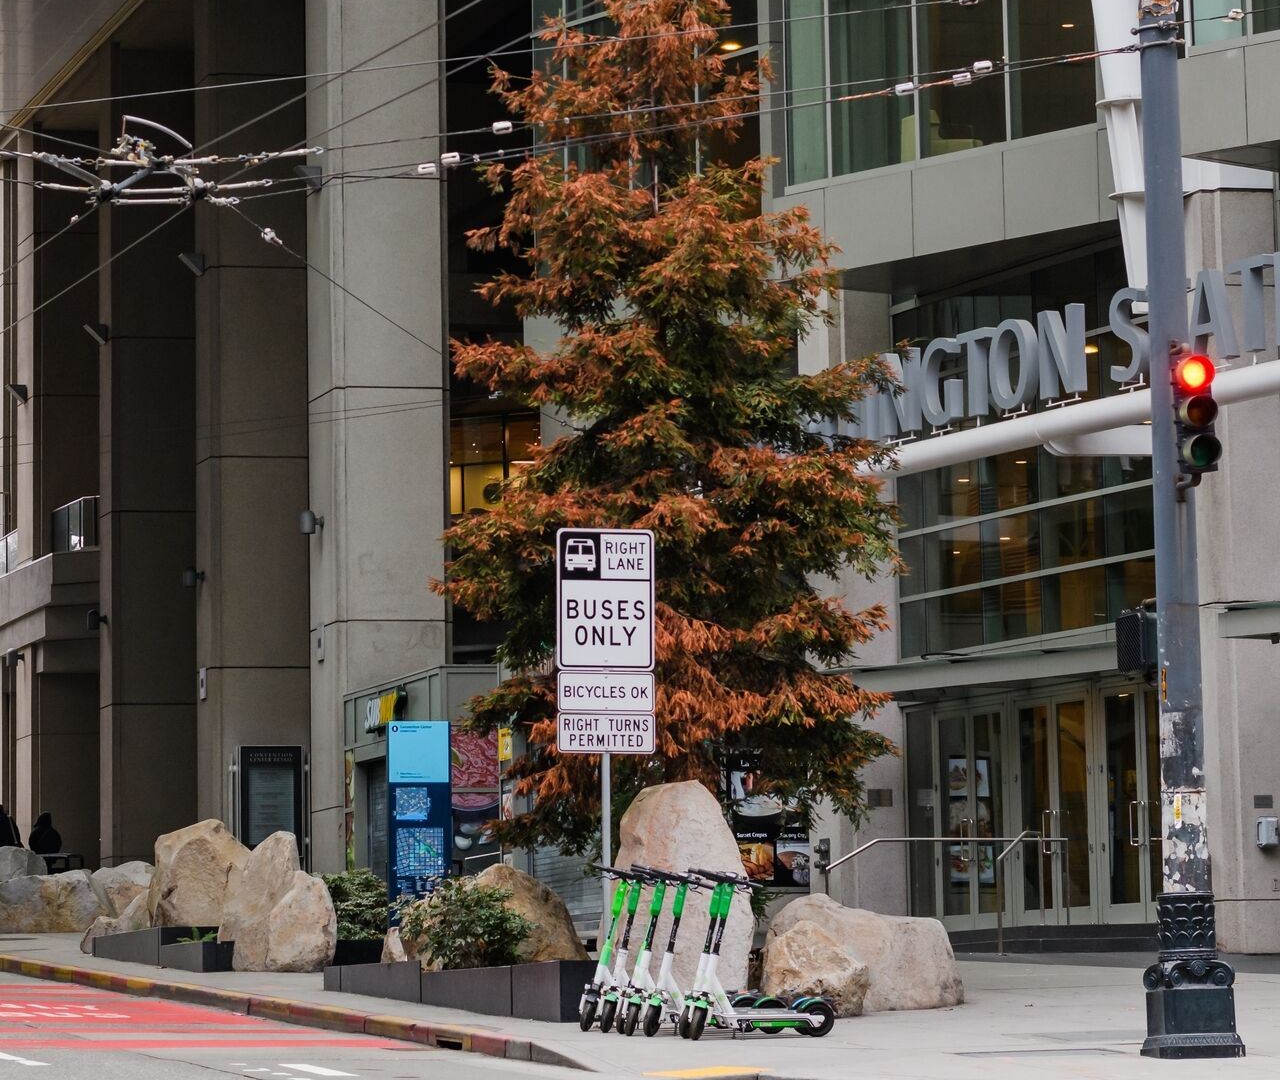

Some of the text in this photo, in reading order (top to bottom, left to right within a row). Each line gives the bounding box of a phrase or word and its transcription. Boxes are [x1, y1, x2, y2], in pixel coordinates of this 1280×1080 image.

[605, 541, 646, 554] RIGHT
[608, 558, 645, 571] LANE
[566, 599, 646, 620] BUSES
[574, 625, 637, 646] ONLY
[563, 685, 649, 699] BICYCLES OK
[563, 718, 649, 732] RIGHT TURNS
[569, 733, 644, 747] PERMITTED
